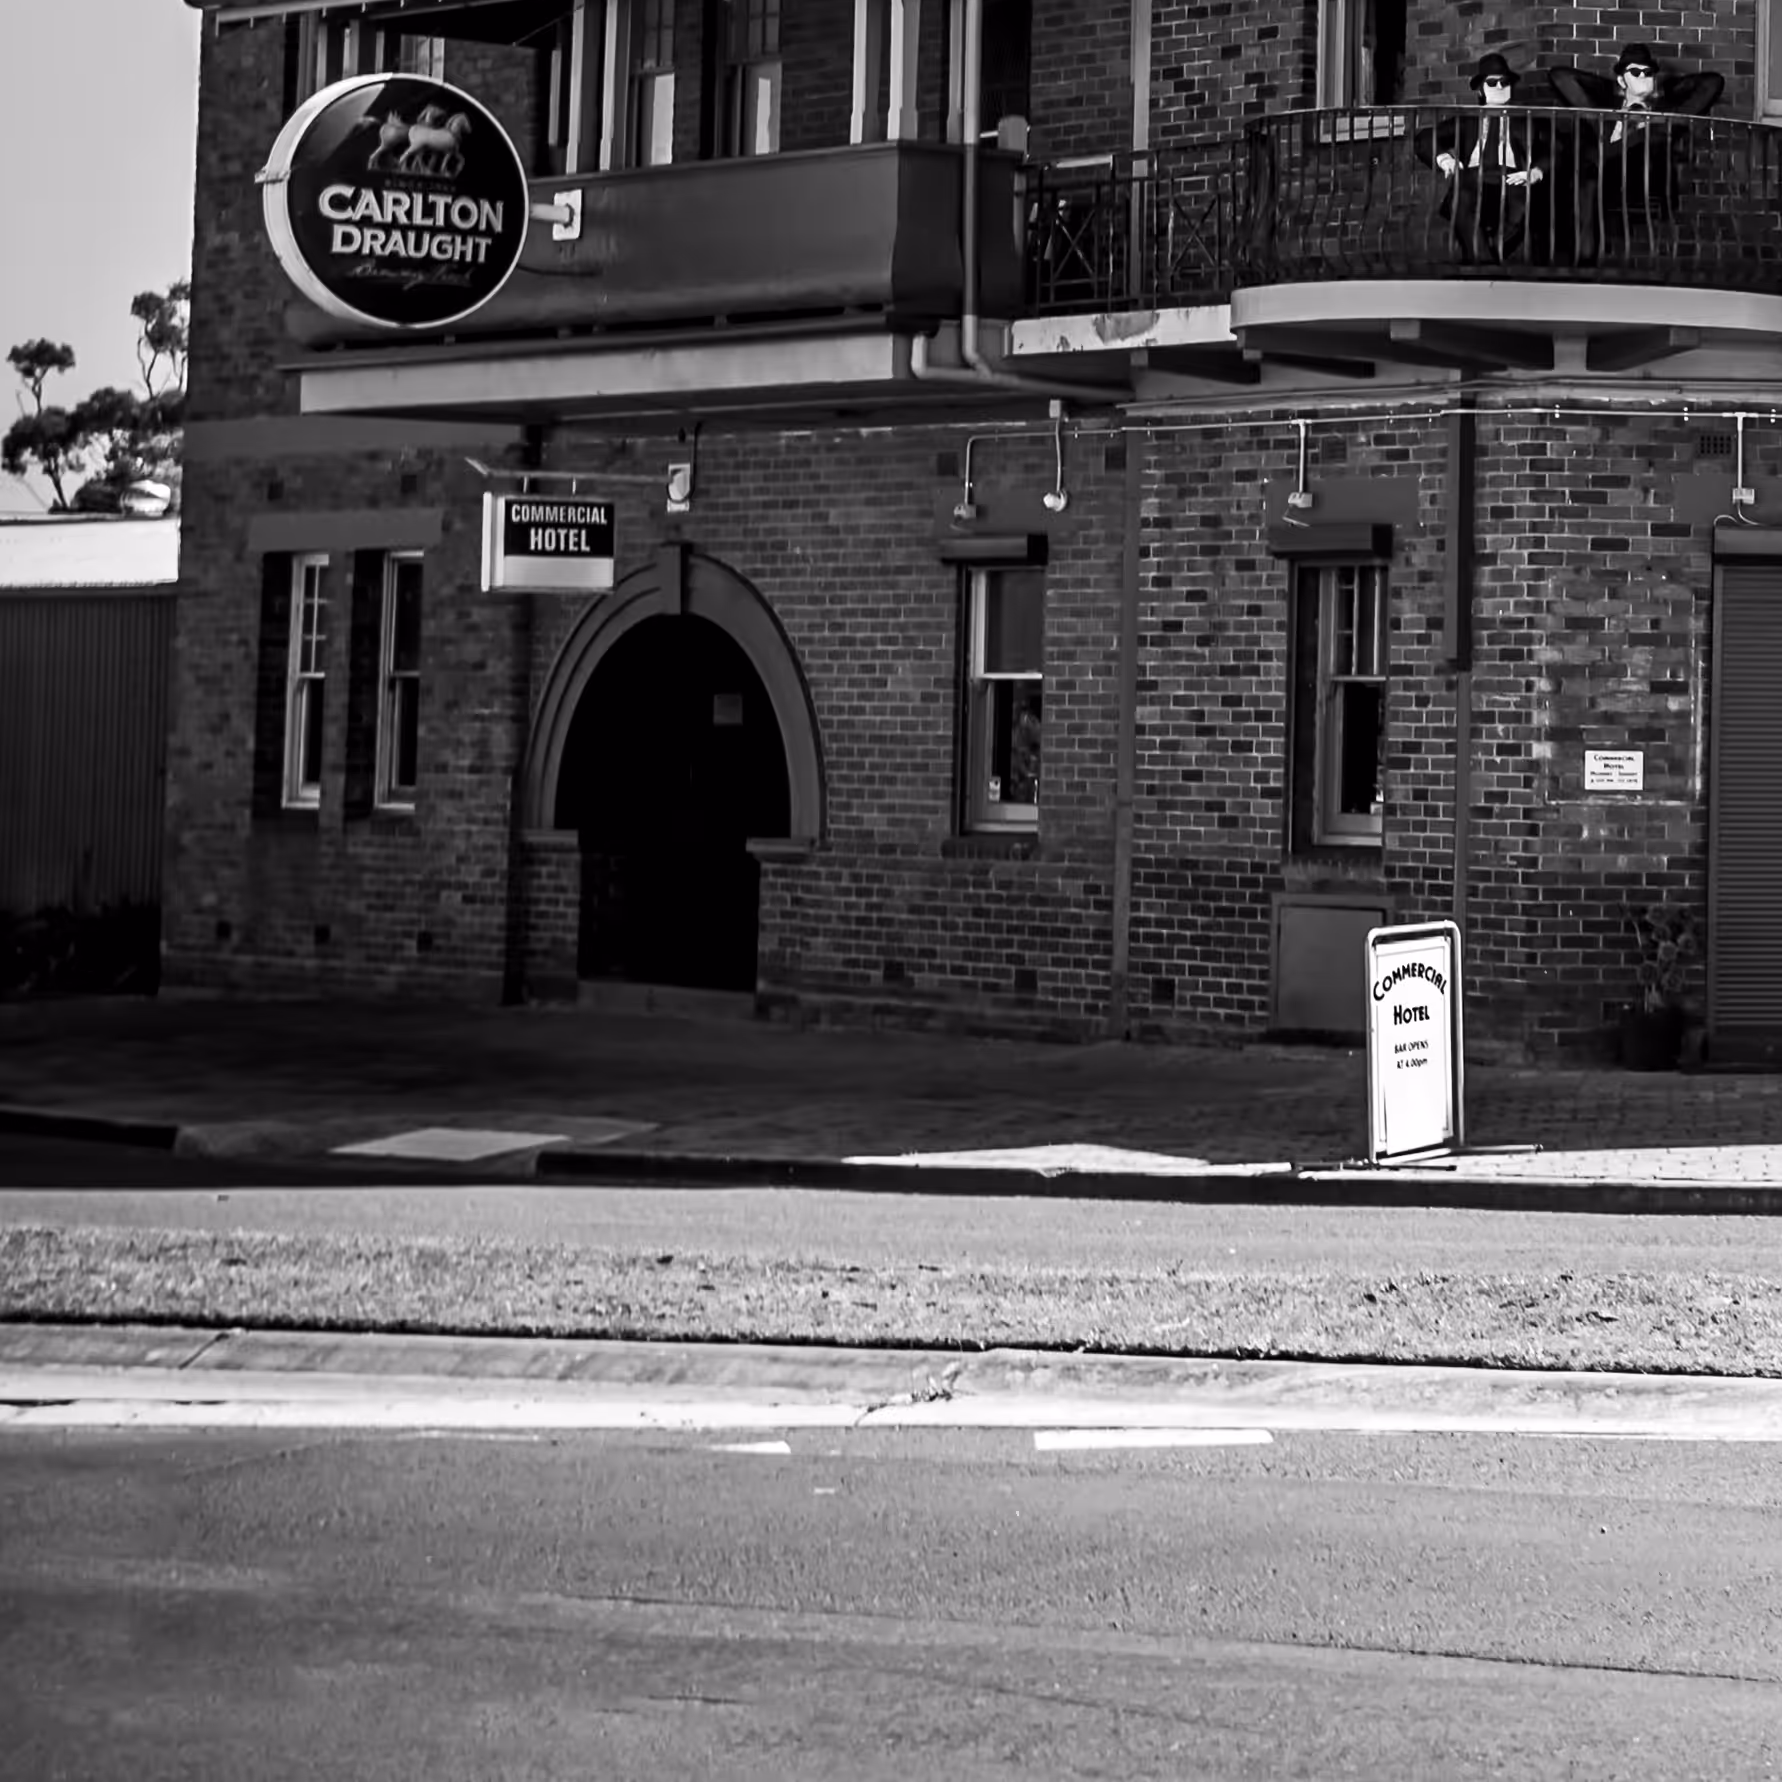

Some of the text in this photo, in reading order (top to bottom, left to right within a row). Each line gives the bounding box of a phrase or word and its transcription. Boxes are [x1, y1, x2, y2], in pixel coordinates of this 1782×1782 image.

[318, 184, 504, 233] CARLTON
[330, 224, 492, 263] DRAUGHT
[511, 503, 607, 525] COMMERCIAL
[529, 527, 591, 552] HOTEL
[1373, 962, 1448, 1001] COMMERCIAL
[1393, 1004, 1430, 1025] HOTEL
